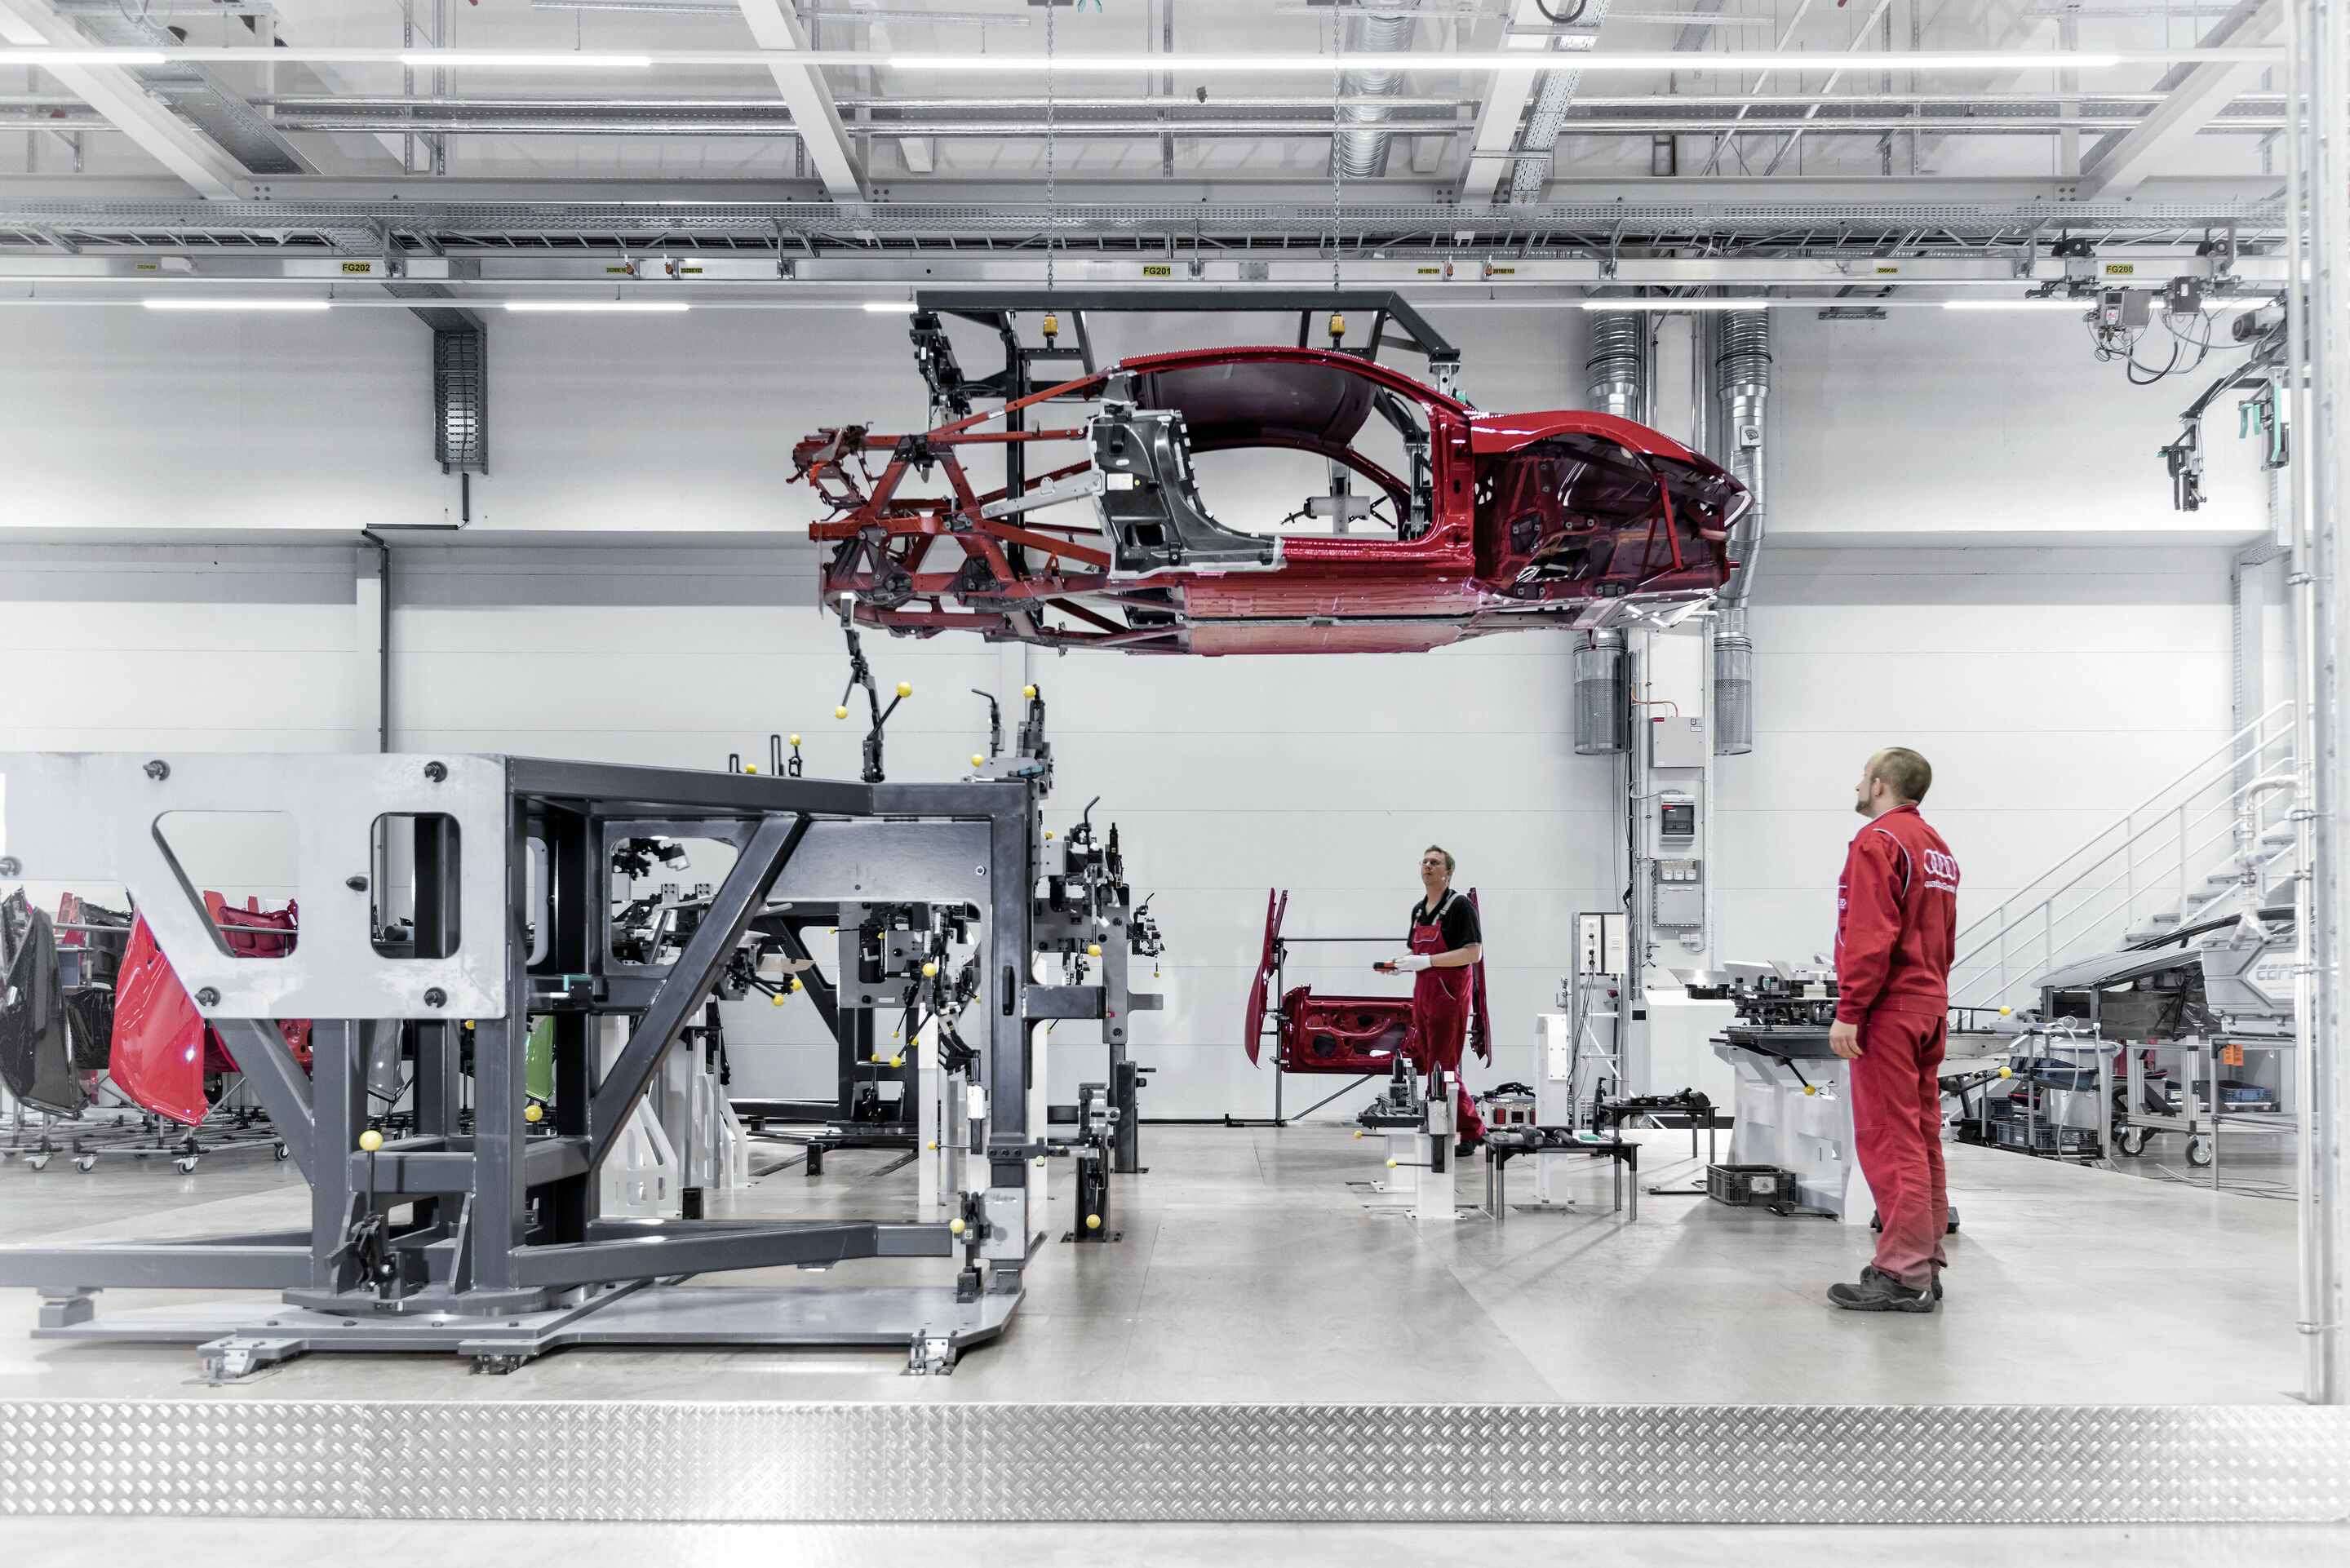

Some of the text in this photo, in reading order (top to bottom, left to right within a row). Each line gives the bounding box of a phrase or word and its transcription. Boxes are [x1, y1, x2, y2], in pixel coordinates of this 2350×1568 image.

[342, 264, 370, 272] FG202
[1143, 267, 1171, 275] FG201
[2106, 265, 2134, 273] FG200
